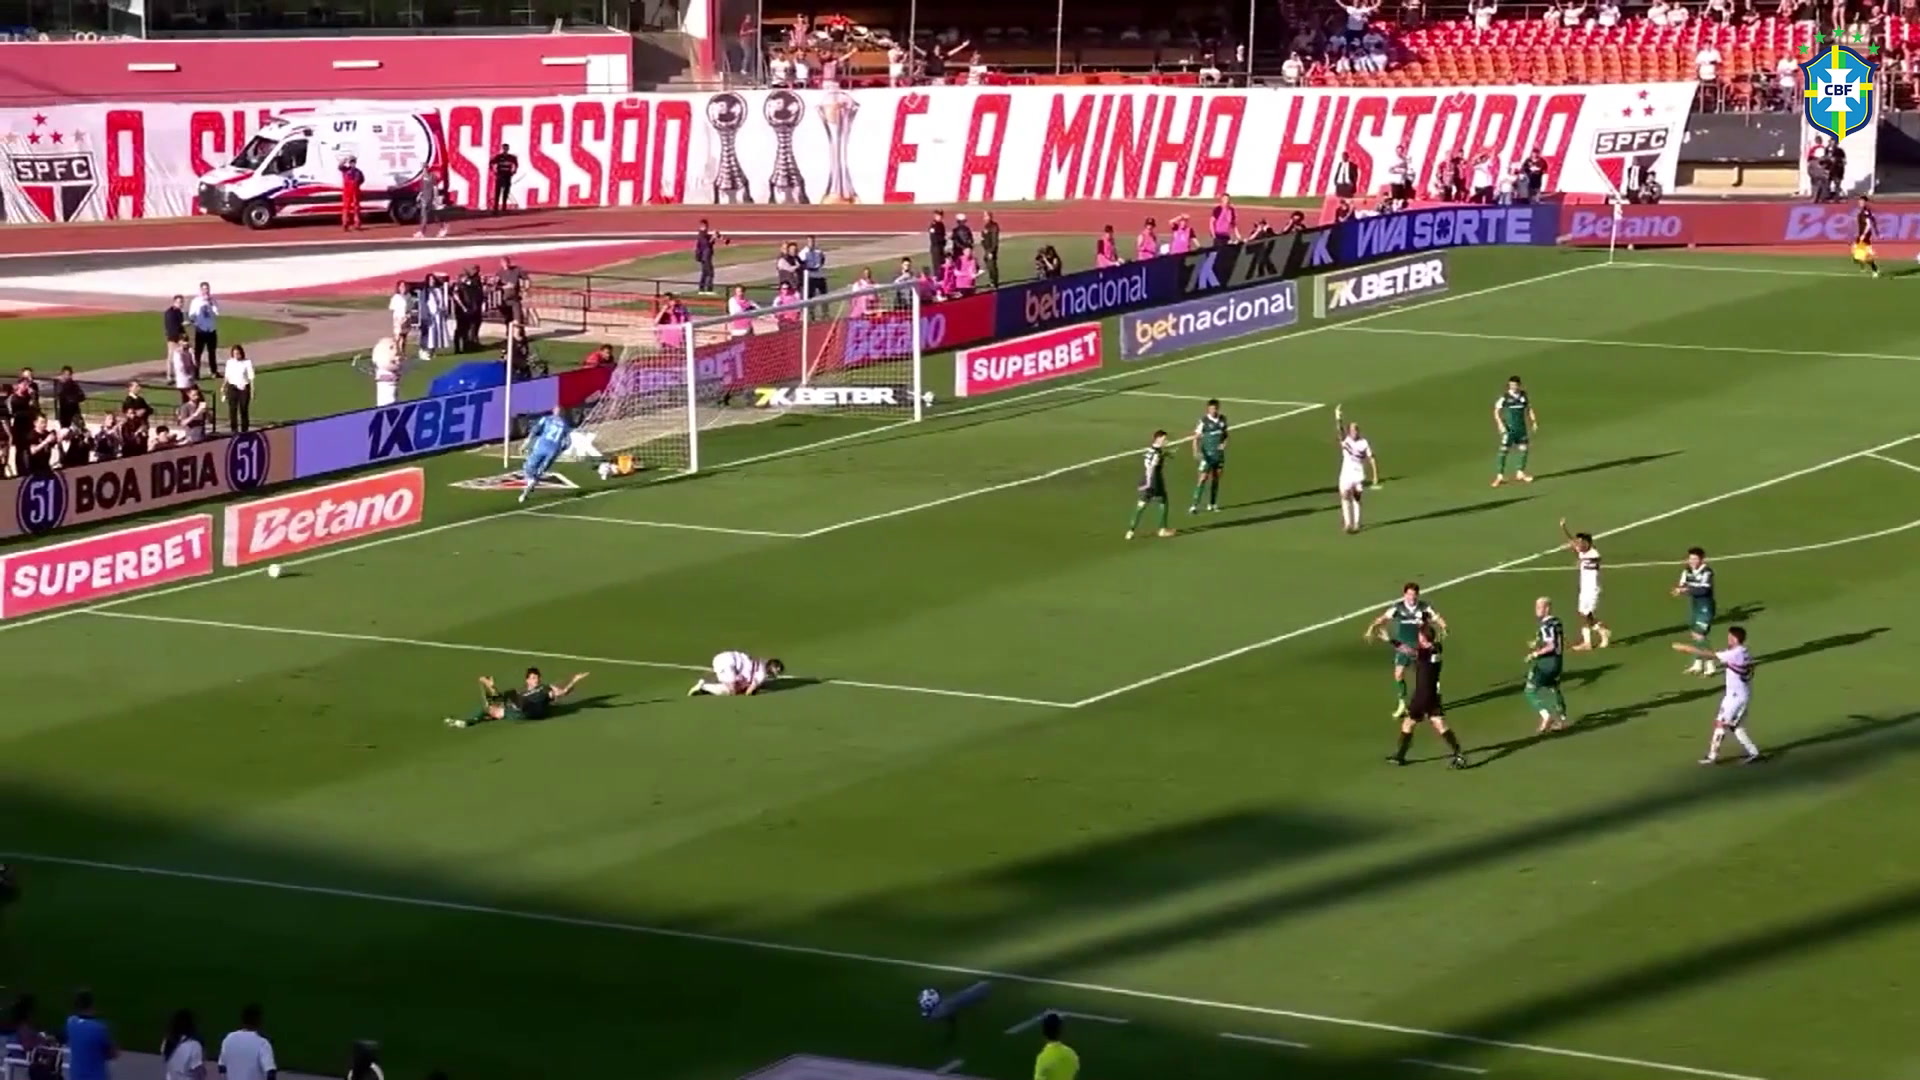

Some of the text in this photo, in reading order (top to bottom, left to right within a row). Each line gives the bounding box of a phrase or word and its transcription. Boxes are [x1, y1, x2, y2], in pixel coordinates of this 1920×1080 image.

[333, 120, 357, 133] UTI
[1598, 130, 1668, 153] SPFC
[16, 159, 89, 179] SPFC
[106, 109, 146, 220] A
[884, 91, 929, 203] É
[958, 94, 1011, 202] A
[1035, 94, 1247, 199] MINHA
[1357, 207, 1532, 259] VIVA SORTE
[1025, 267, 1148, 324] betnacional
[1135, 287, 1295, 346] betnacional
[972, 331, 1098, 381] SUPERBET
[368, 390, 494, 460] 1XBET
[75, 452, 219, 514] BOA IDEIA
[237, 442, 260, 483] 51
[30, 477, 56, 520] 51
[250, 487, 414, 553] Betano
[11, 527, 207, 598] SUPERBET
